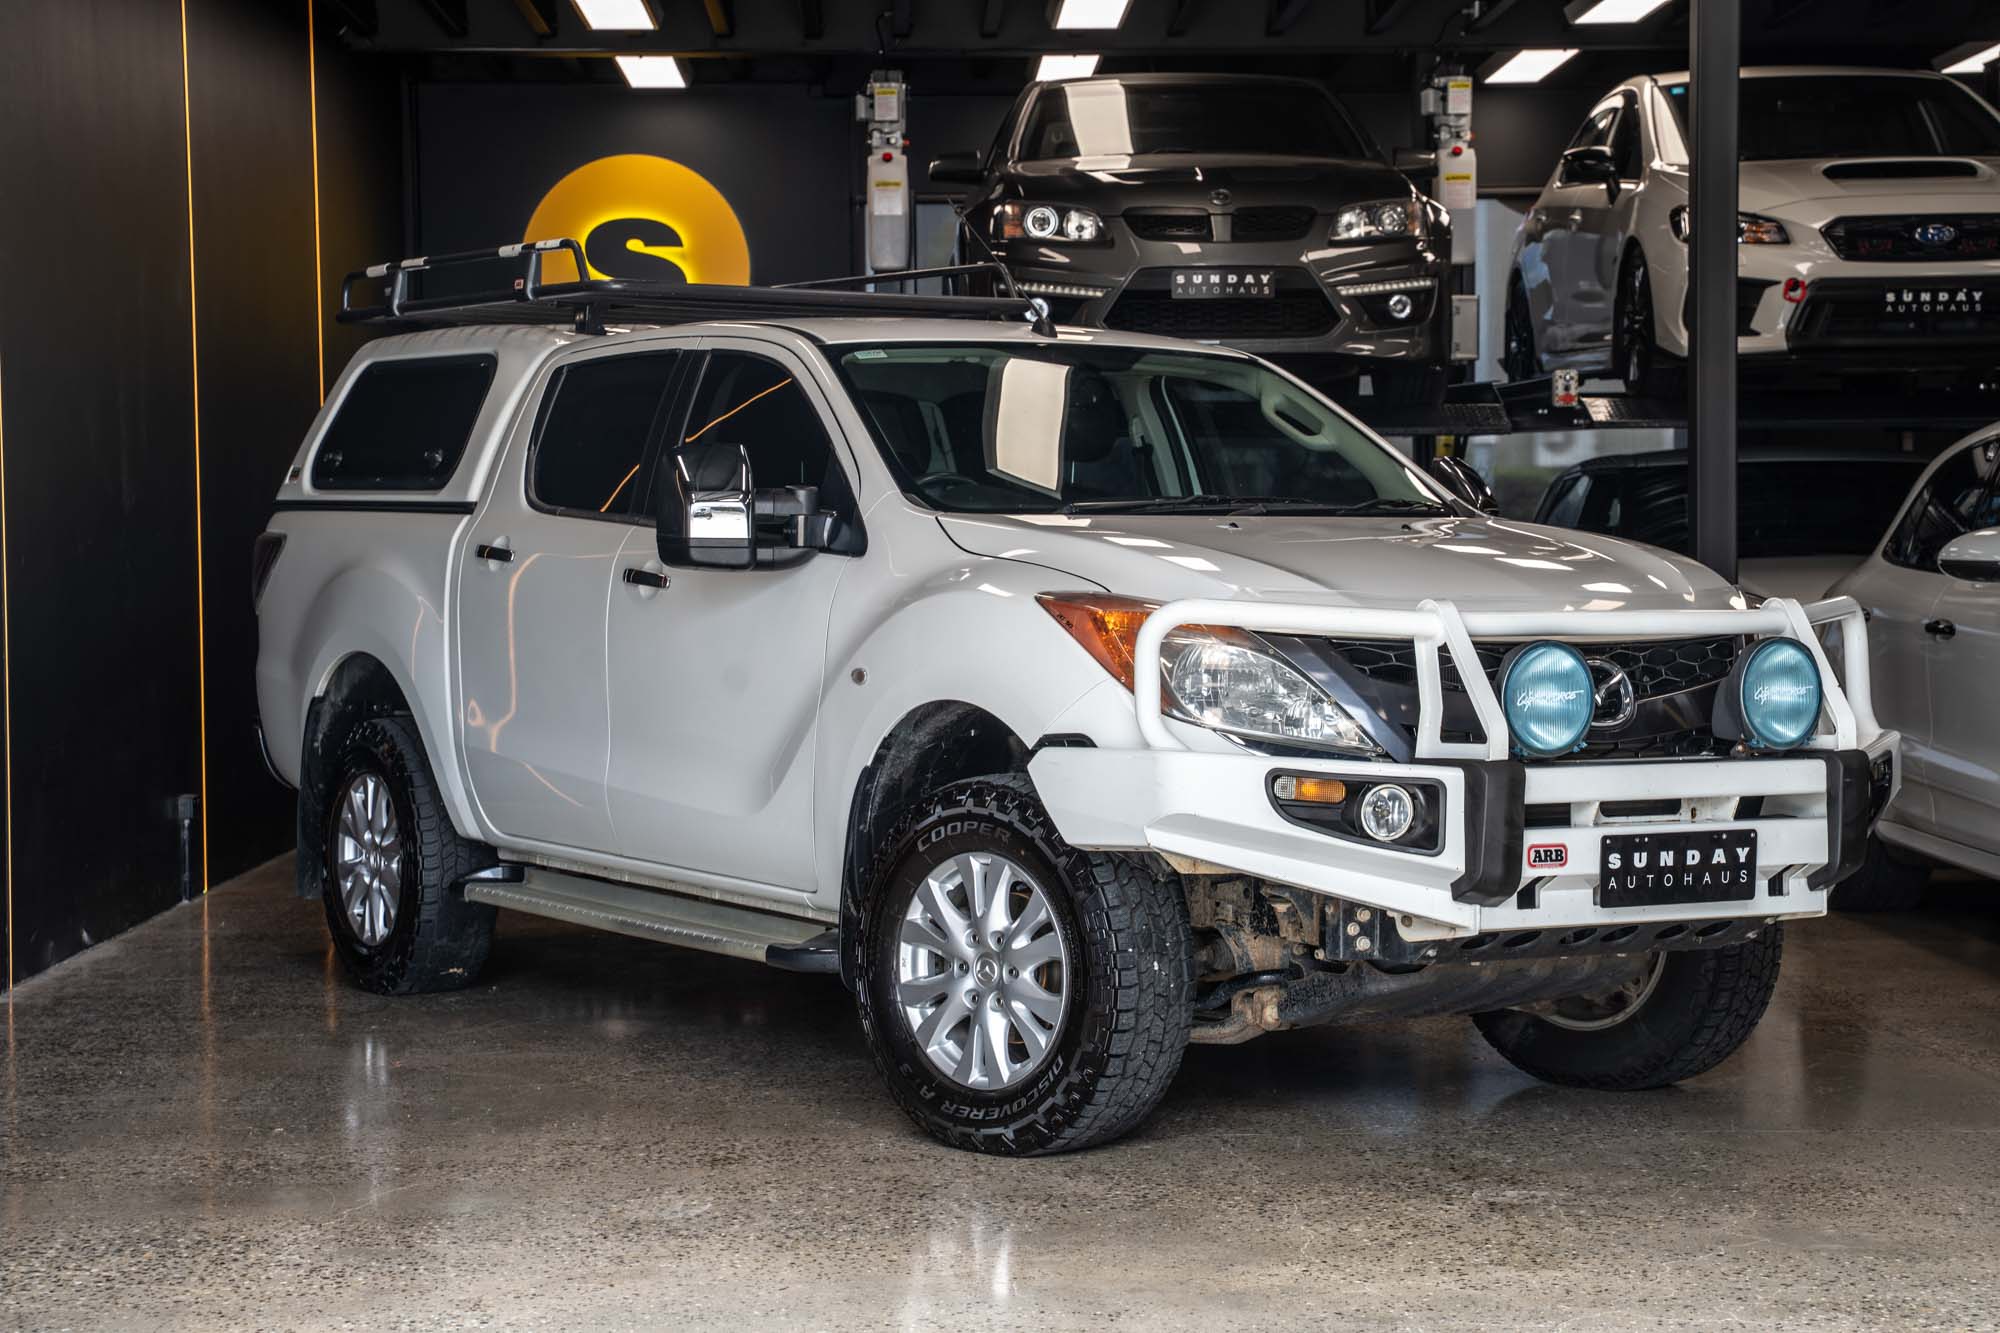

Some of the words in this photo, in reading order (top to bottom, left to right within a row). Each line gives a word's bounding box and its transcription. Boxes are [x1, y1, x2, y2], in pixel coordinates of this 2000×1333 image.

[584, 217, 688, 285] S
[1176, 274, 1270, 284] SUNDAY
[1176, 286, 1270, 295] AUTOHAUS
[1886, 291, 1983, 302] SUNDAY
[1886, 303, 1982, 312] AUTOHAUS
[917, 821, 1011, 852] COOPER
[1532, 848, 1564, 864] ARB
[1607, 847, 1750, 870] SUNDAY
[1608, 869, 1748, 890] AUTOHAUS
[940, 1055, 1064, 1121] DISCOVERER
